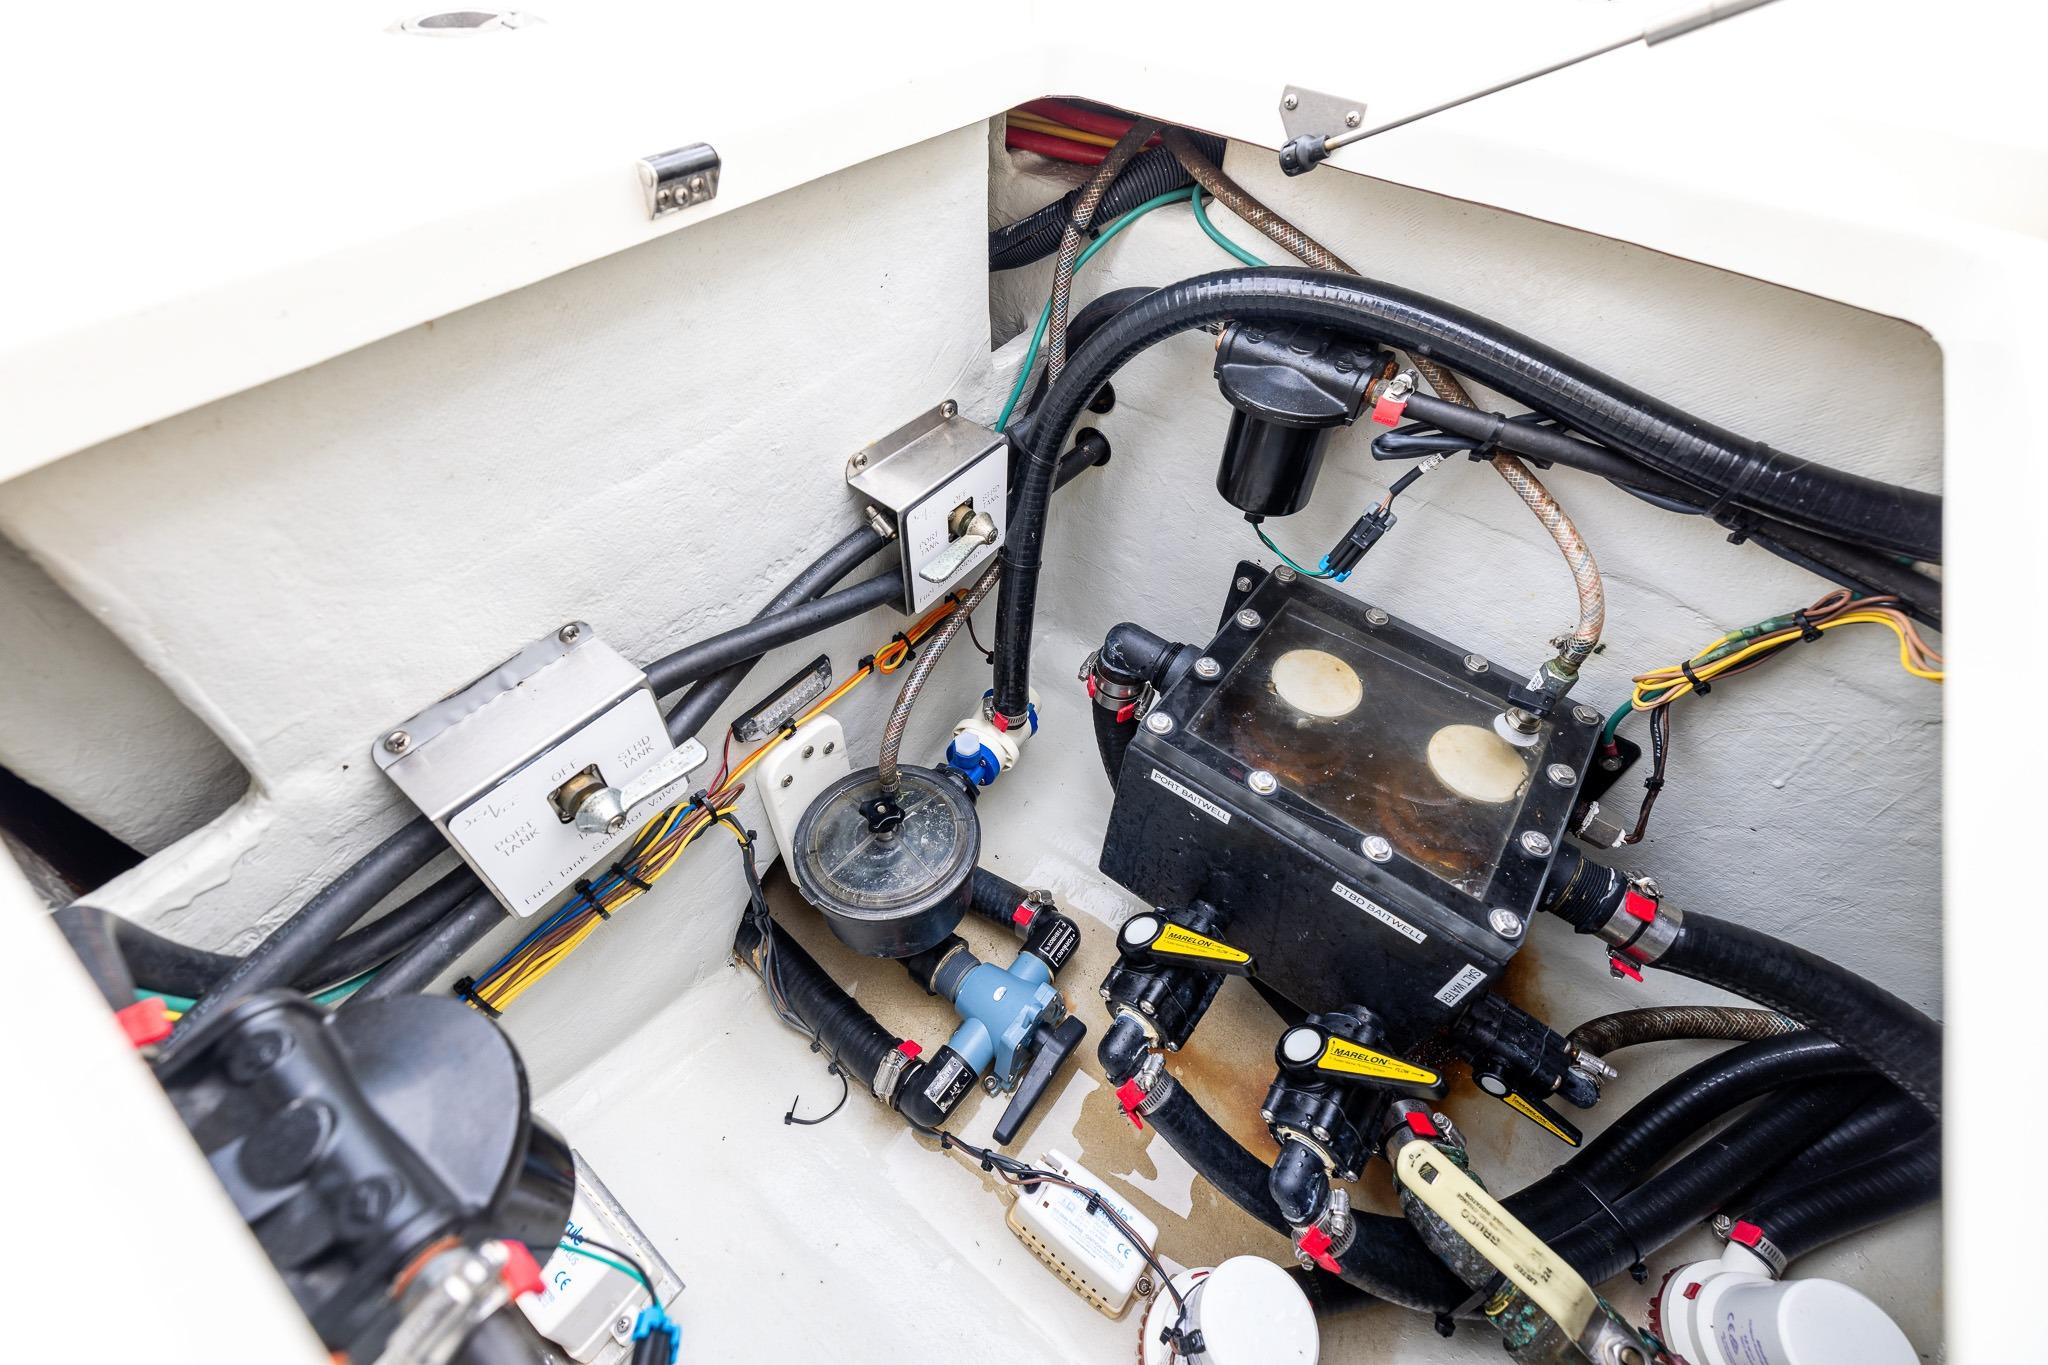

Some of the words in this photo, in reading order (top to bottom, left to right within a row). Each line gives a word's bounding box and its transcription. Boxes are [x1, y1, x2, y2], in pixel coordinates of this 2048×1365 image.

[623, 746, 656, 769] TANK
[1154, 773, 1180, 791] PORT
[1181, 790, 1229, 820] BAITWELL
[493, 818, 533, 852] PORT
[503, 827, 542, 857] TANK
[524, 880, 553, 905] Fuel
[560, 854, 588, 878] Tank
[648, 782, 679, 808] Valve
[1334, 884, 1365, 905] STBD
[1366, 903, 1422, 941] BAITWELL
[1056, 935, 1074, 958] FORWARD
[1168, 933, 1213, 947] MARELON
[1460, 967, 1482, 988] SALT
[1440, 980, 1466, 1005] WATER
[1334, 1048, 1388, 1065] MARELON
[948, 1081, 960, 1096] AFT
